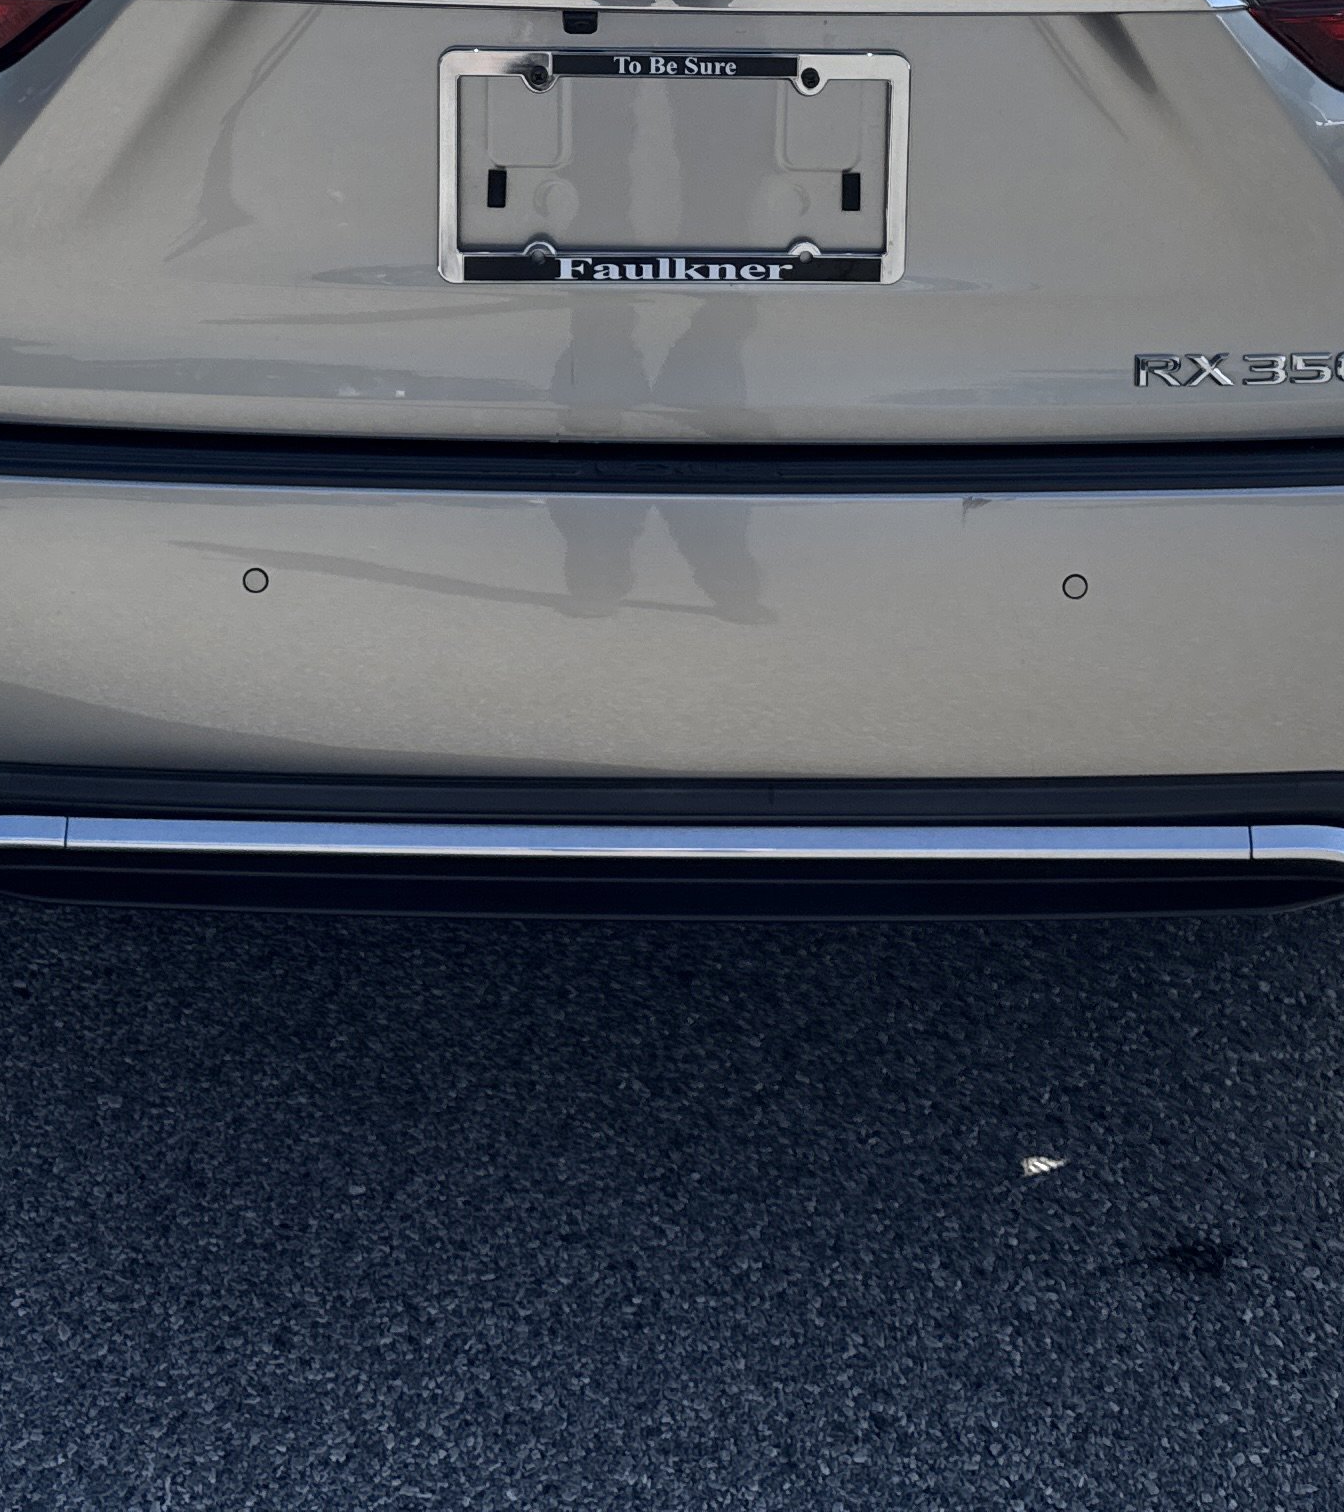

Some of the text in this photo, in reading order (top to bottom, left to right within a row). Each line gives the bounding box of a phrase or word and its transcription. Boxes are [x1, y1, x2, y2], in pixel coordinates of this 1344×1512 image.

[613, 56, 738, 76] To Be Sure
[555, 257, 794, 281] Faulkner
[1133, 352, 1235, 387] RX
